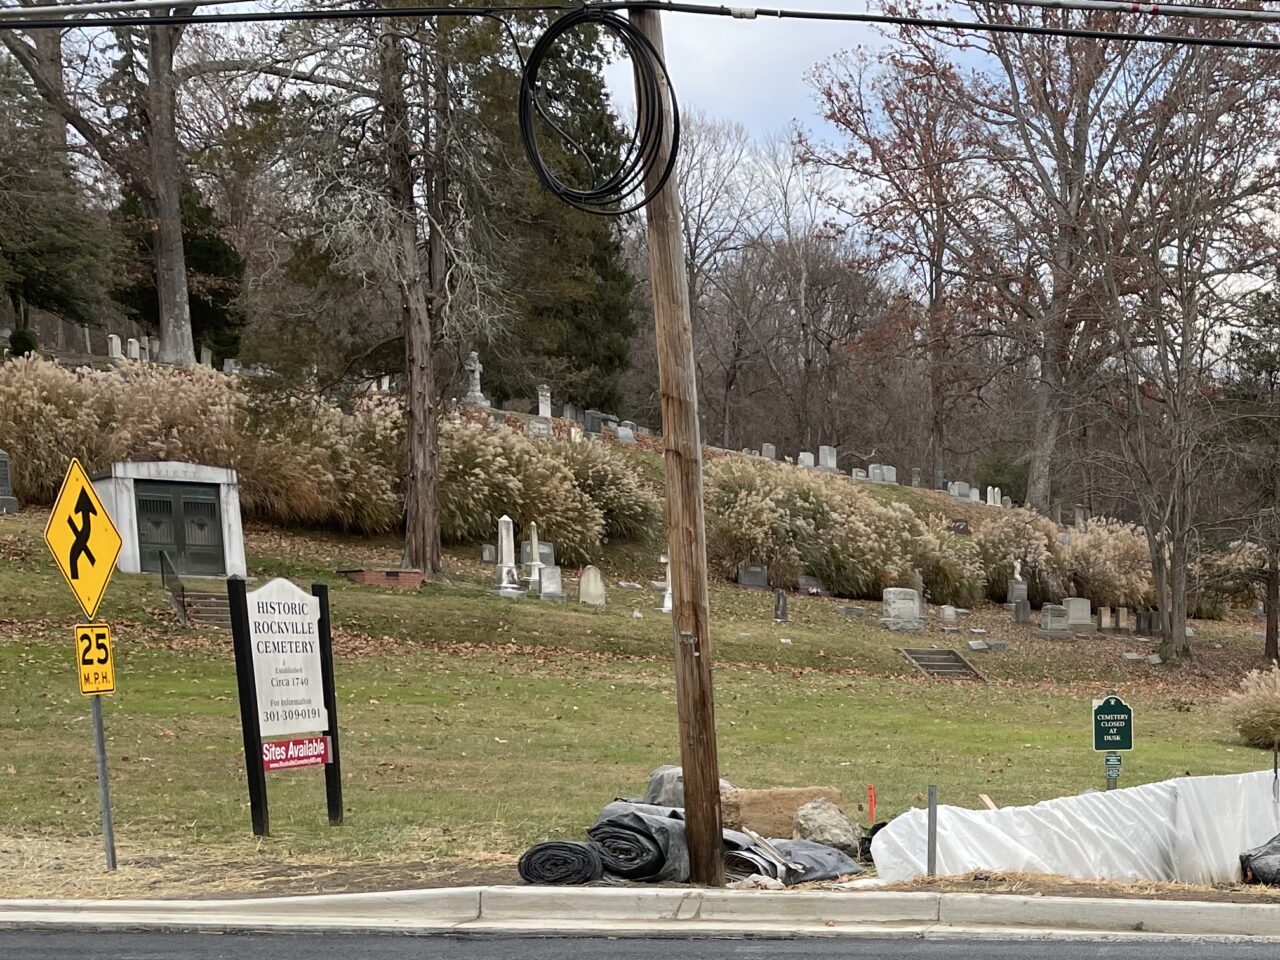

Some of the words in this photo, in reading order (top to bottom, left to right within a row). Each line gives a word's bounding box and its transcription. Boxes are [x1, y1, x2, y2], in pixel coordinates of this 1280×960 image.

[256, 601, 309, 616] HISTORIC
[253, 620, 315, 635] ROCKVILLE
[79, 633, 109, 666] 25
[256, 640, 315, 654] CEMETERY
[274, 666, 303, 675] Established
[83, 671, 111, 686] M.P.H.
[270, 677, 290, 688] Circa
[292, 677, 309, 687] 1740
[270, 699, 280, 708] For
[280, 698, 312, 707] Information
[262, 708, 321, 723] 301-309-0191
[262, 743, 287, 762] Sites
[287, 738, 325, 759] Available
